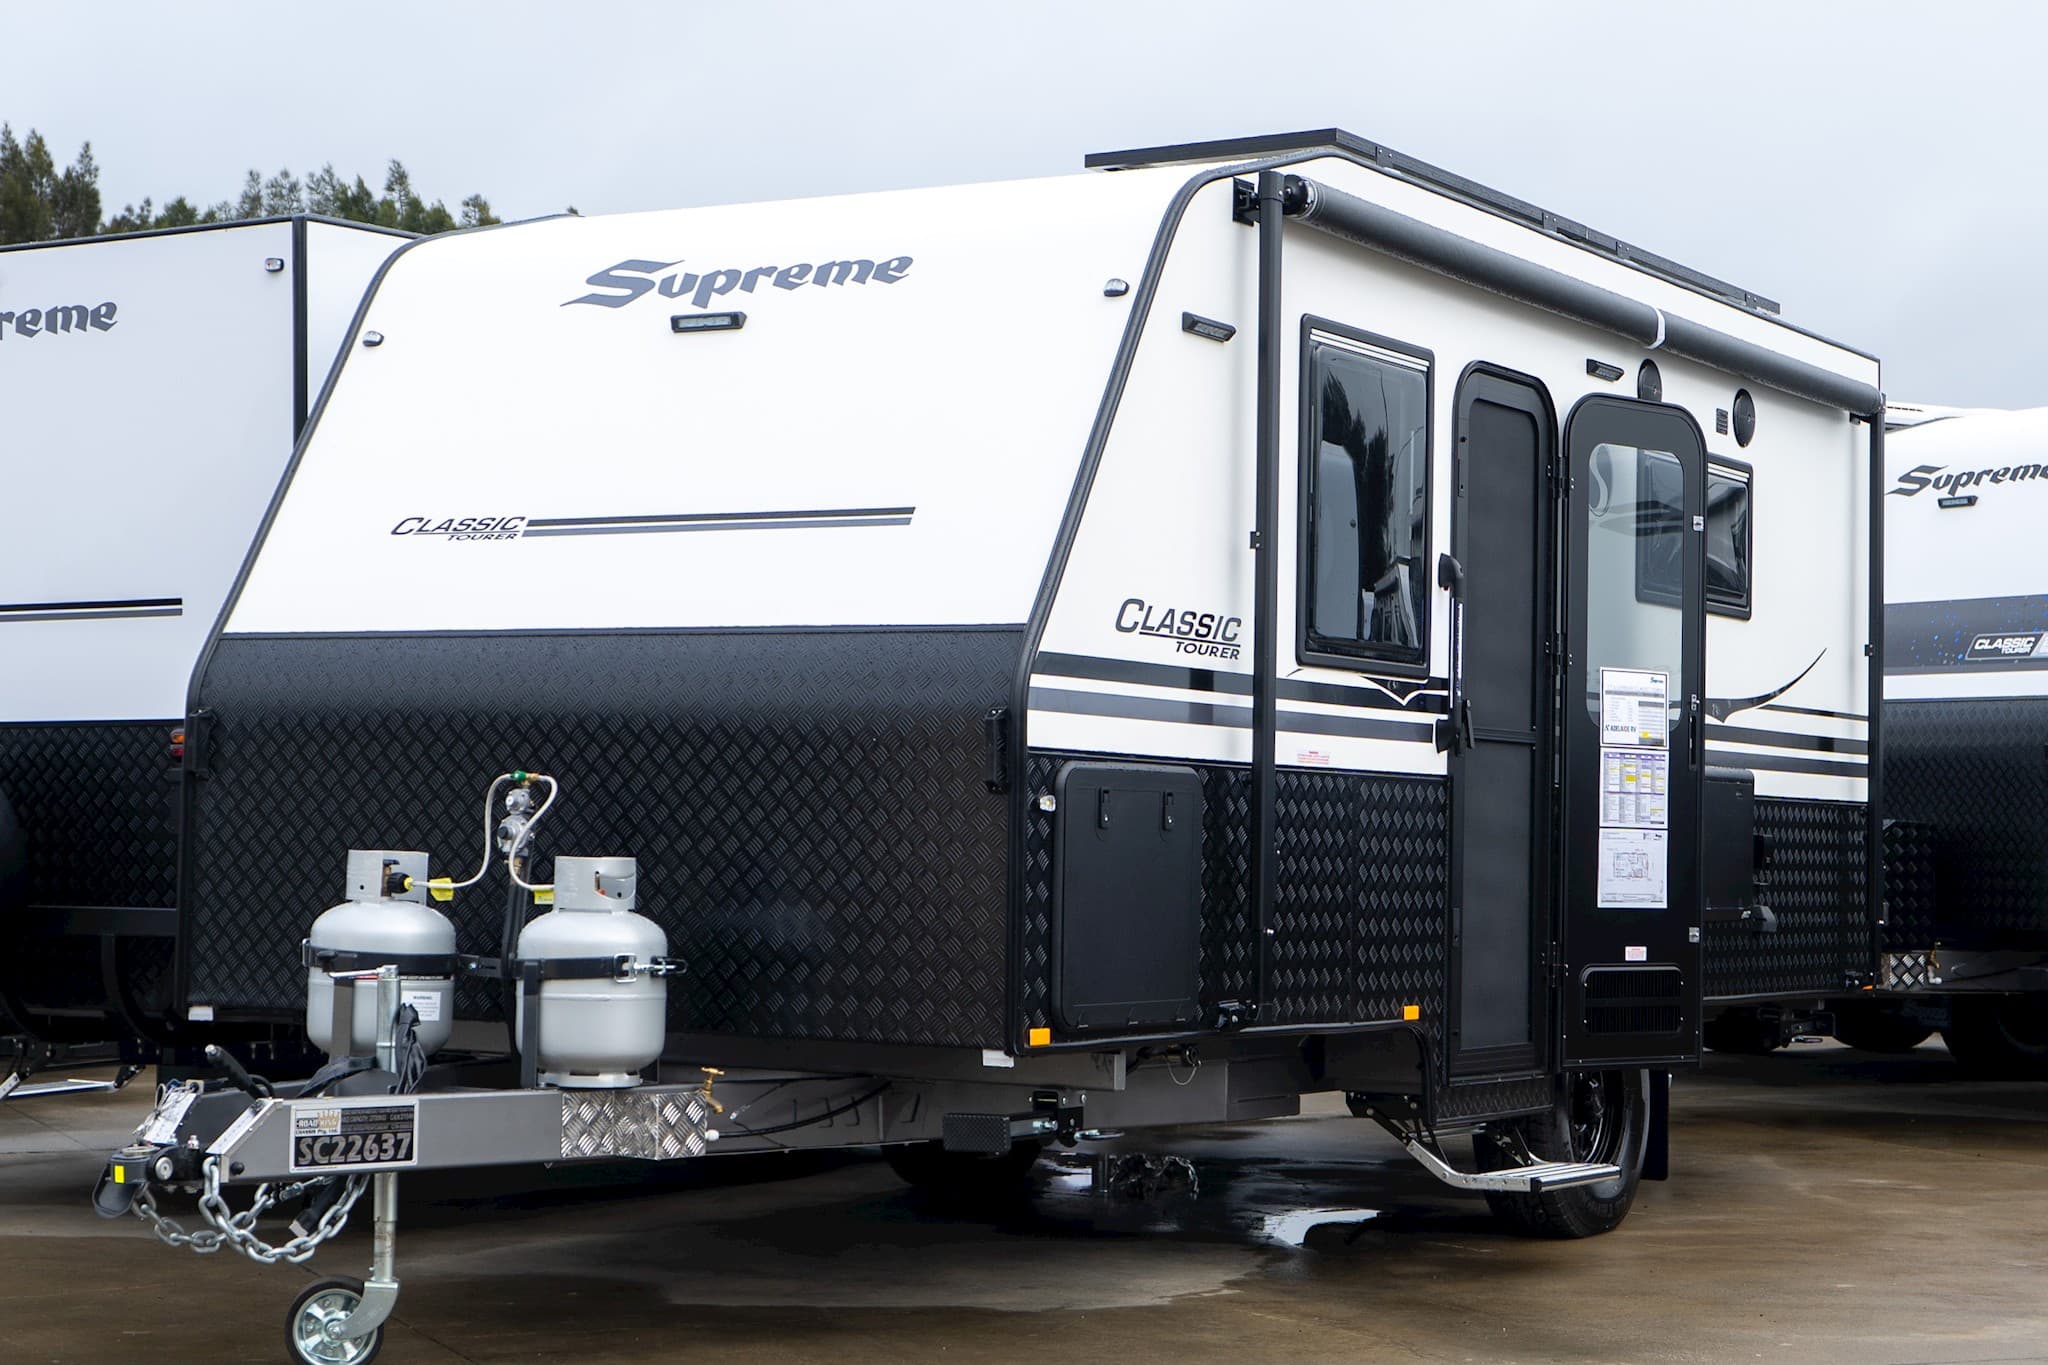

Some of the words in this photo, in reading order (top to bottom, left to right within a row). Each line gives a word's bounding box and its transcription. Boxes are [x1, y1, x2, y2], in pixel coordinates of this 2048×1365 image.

[560, 255, 914, 309] Supreme
[391, 516, 526, 535] CLASSIC
[447, 533, 518, 541] TOURER
[1115, 598, 1242, 642] CLASSIC
[1176, 641, 1240, 660] TOURER
[1974, 637, 2036, 650] CLASSIC
[298, 1131, 412, 1166] SC22637
